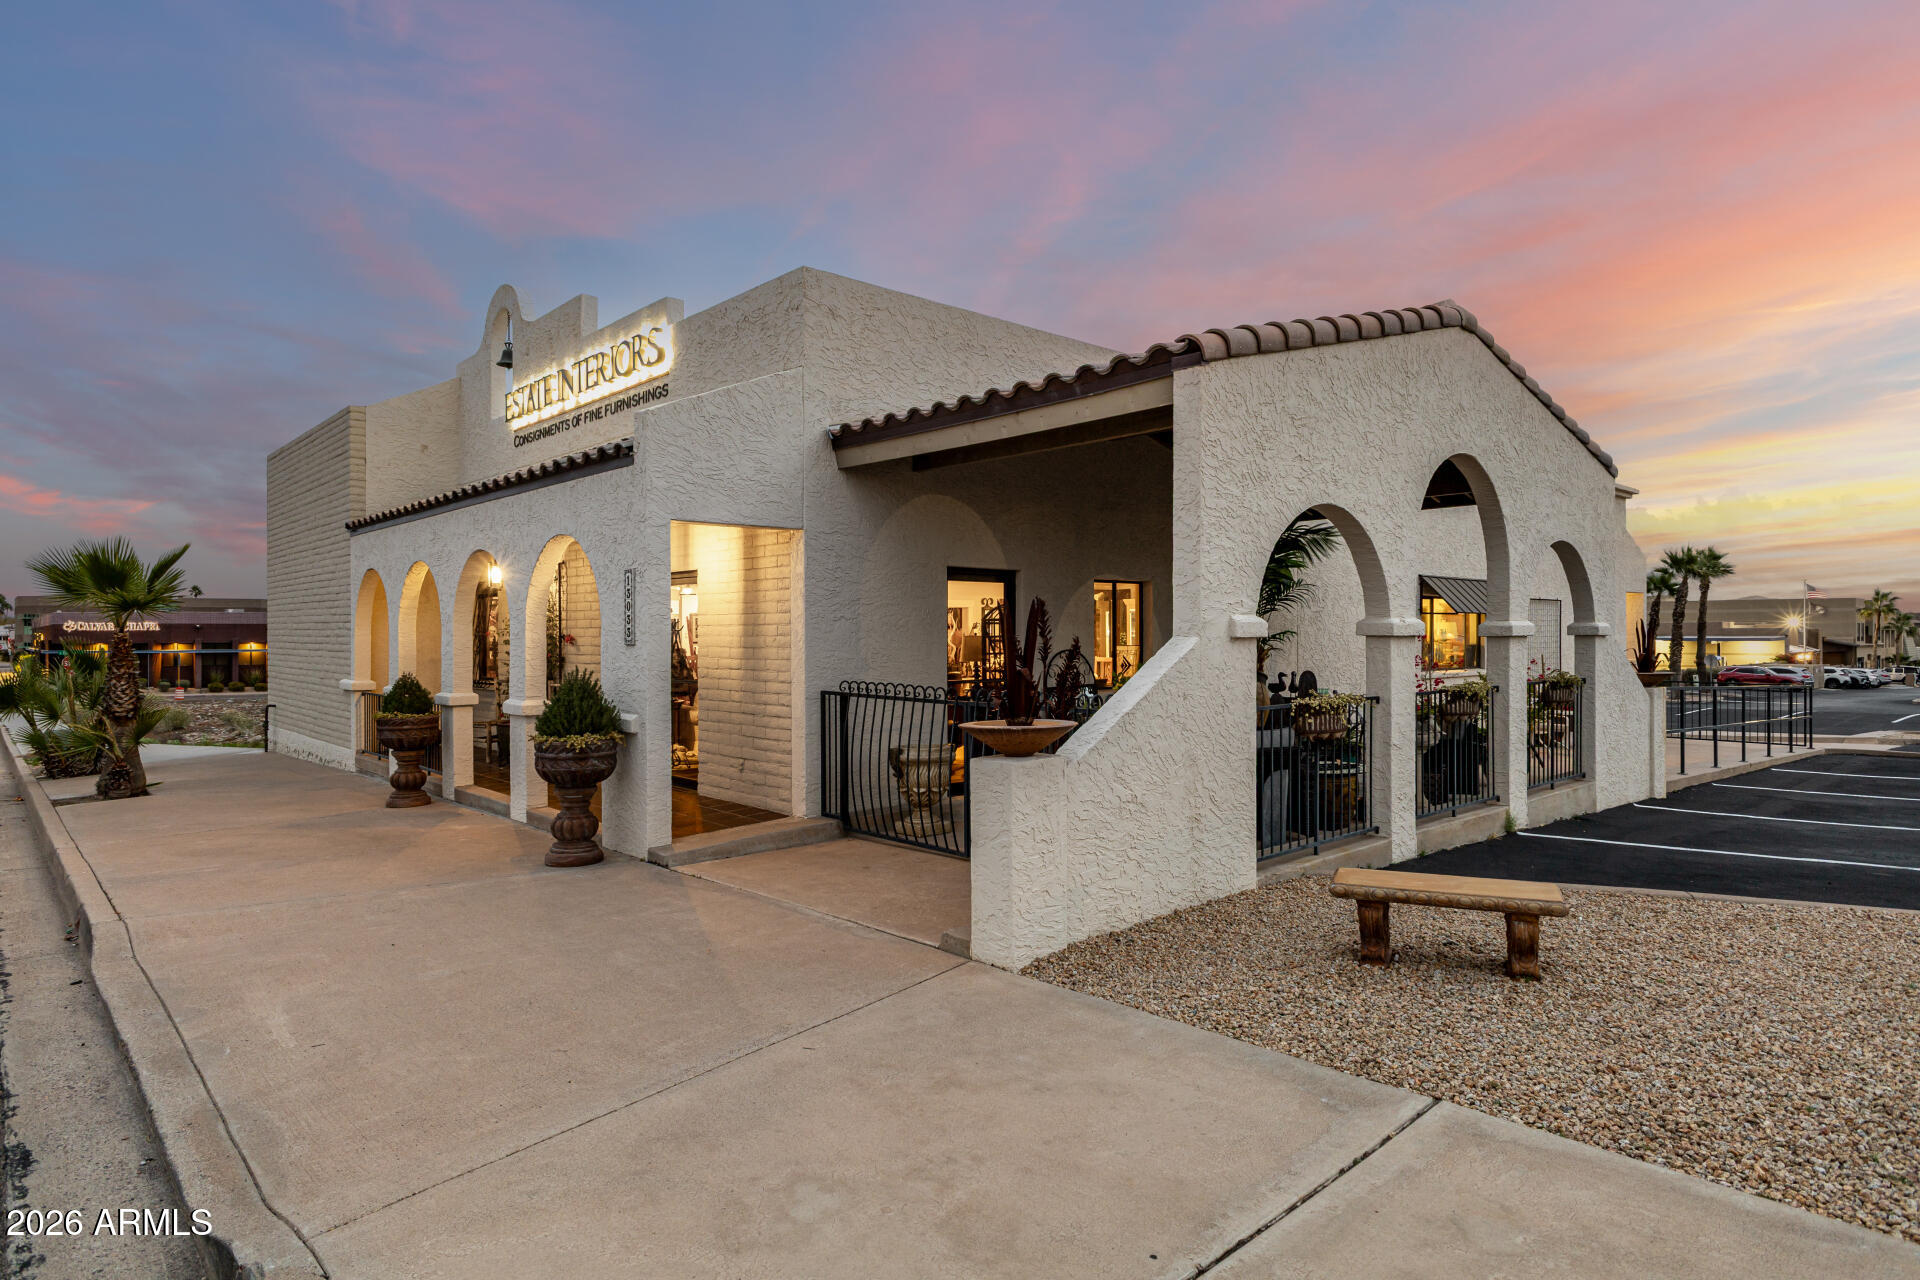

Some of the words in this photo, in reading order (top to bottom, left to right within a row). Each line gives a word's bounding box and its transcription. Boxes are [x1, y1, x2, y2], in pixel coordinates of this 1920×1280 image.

[505, 373, 556, 423] ESTATE
[556, 327, 666, 402] INTERIORS
[513, 418, 571, 448] CONSIGNMENTS
[571, 413, 583, 428] OF
[583, 405, 603, 425] FINE
[604, 383, 669, 418] FURNISHINGS
[77, 620, 117, 632] CALVAR
